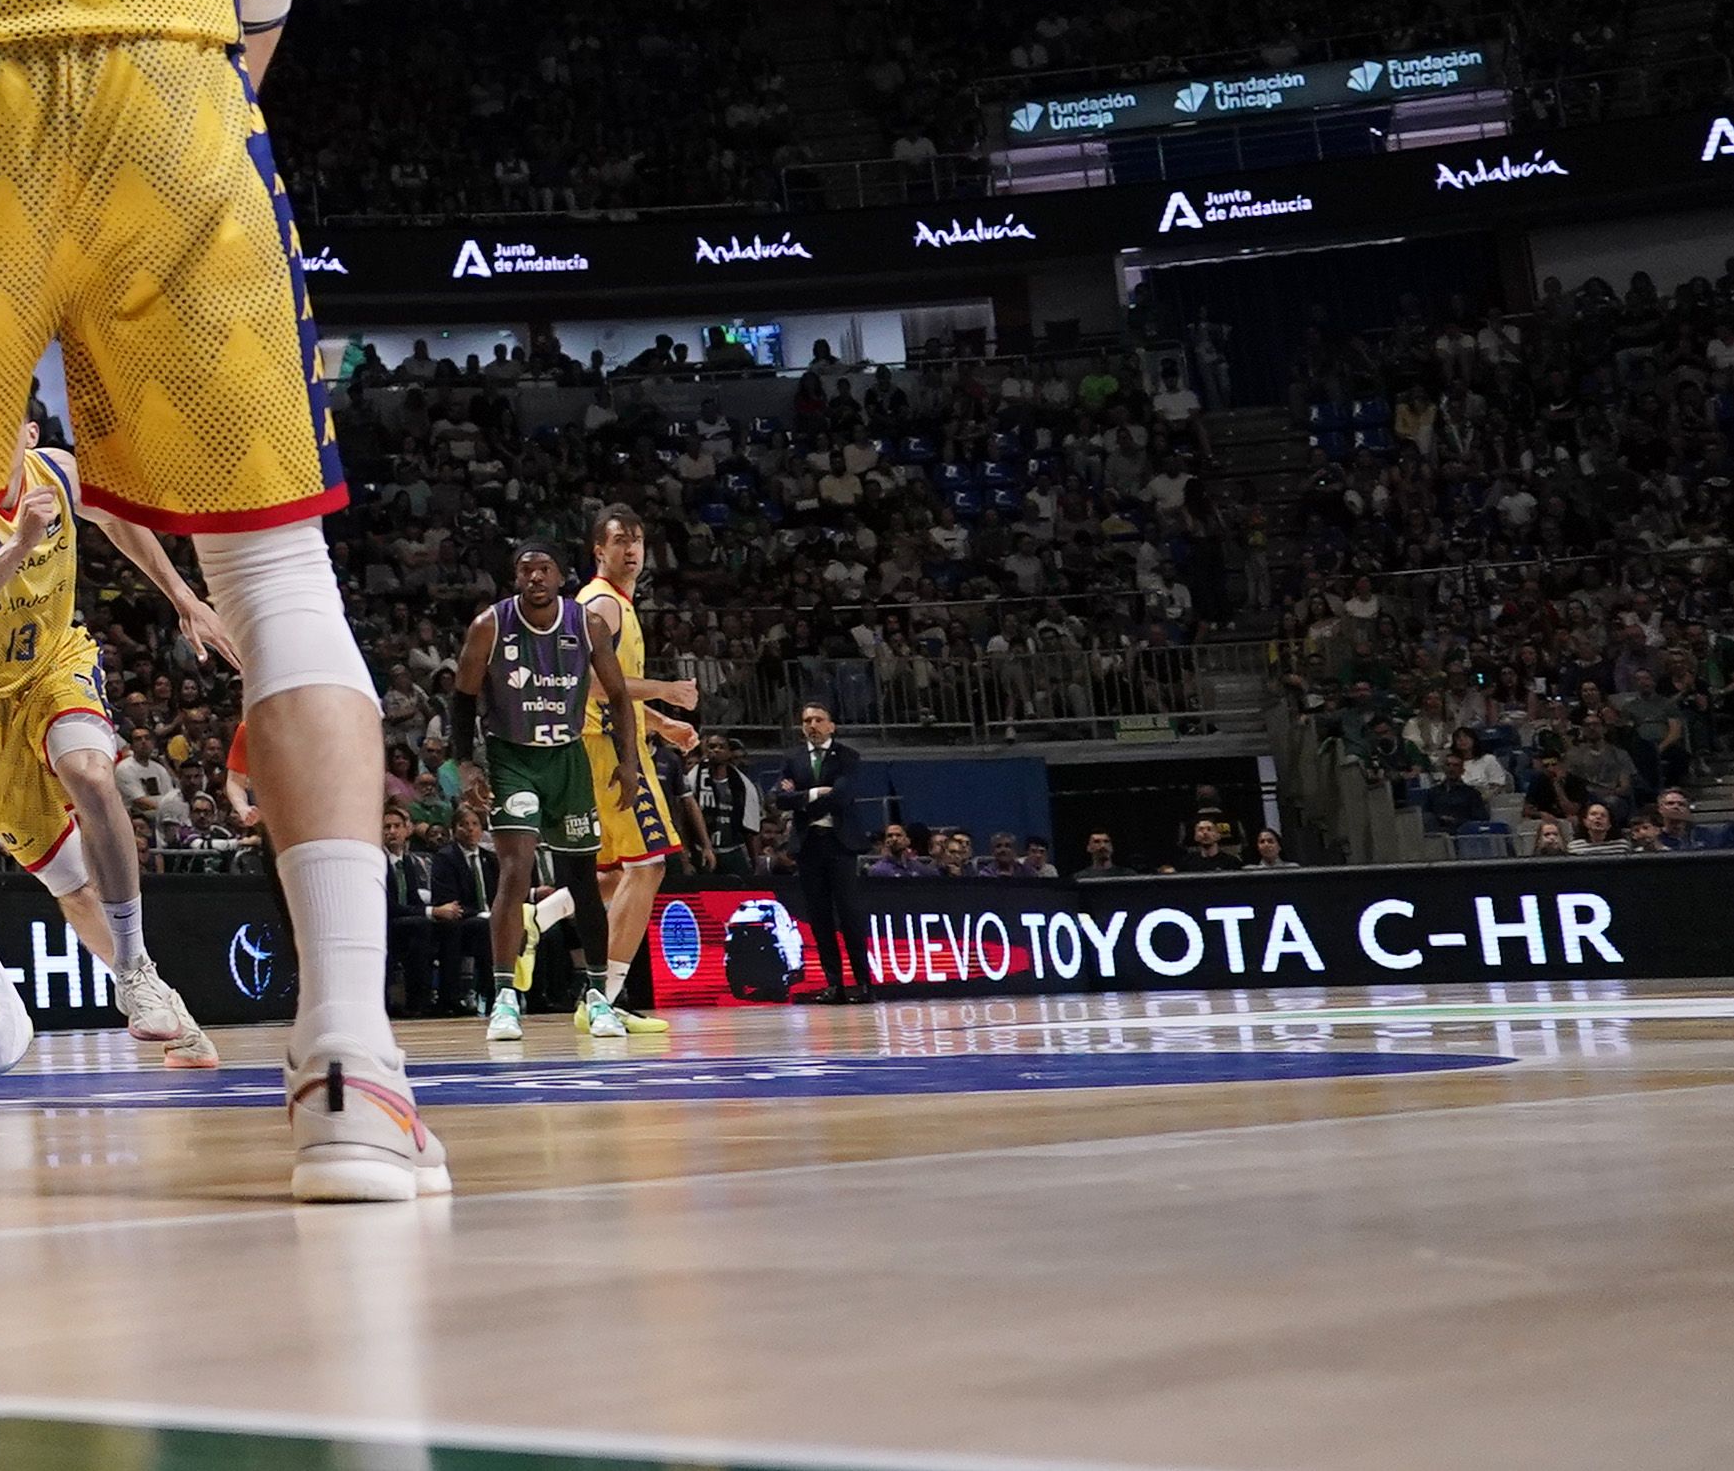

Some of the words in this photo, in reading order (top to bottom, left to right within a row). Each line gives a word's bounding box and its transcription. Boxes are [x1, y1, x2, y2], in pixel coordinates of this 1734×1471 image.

[1387, 49, 1483, 77] Fundación
[1212, 71, 1306, 100] Fundación
[1389, 66, 1459, 91] Unicaja
[1047, 92, 1137, 118] Fundación
[1214, 86, 1284, 112] Unicaja
[1050, 106, 1115, 131] Unicaja
[1435, 148, 1571, 191] Andalucía
[1204, 187, 1254, 210] Junta
[1204, 203, 1227, 222] de
[1228, 193, 1314, 220] Andalucía
[913, 213, 1037, 249] Andalucía
[493, 243, 537, 258] Junta
[695, 230, 814, 267] Andalucía
[494, 257, 513, 273] de
[515, 254, 590, 273] Andalucía
[6, 623, 38, 664] 13
[532, 673, 579, 692] Unicaja
[522, 697, 567, 717] málag
[534, 724, 573, 746] 55
[1021, 904, 1327, 979] TOYOTA
[1359, 891, 1624, 971] C-HR
